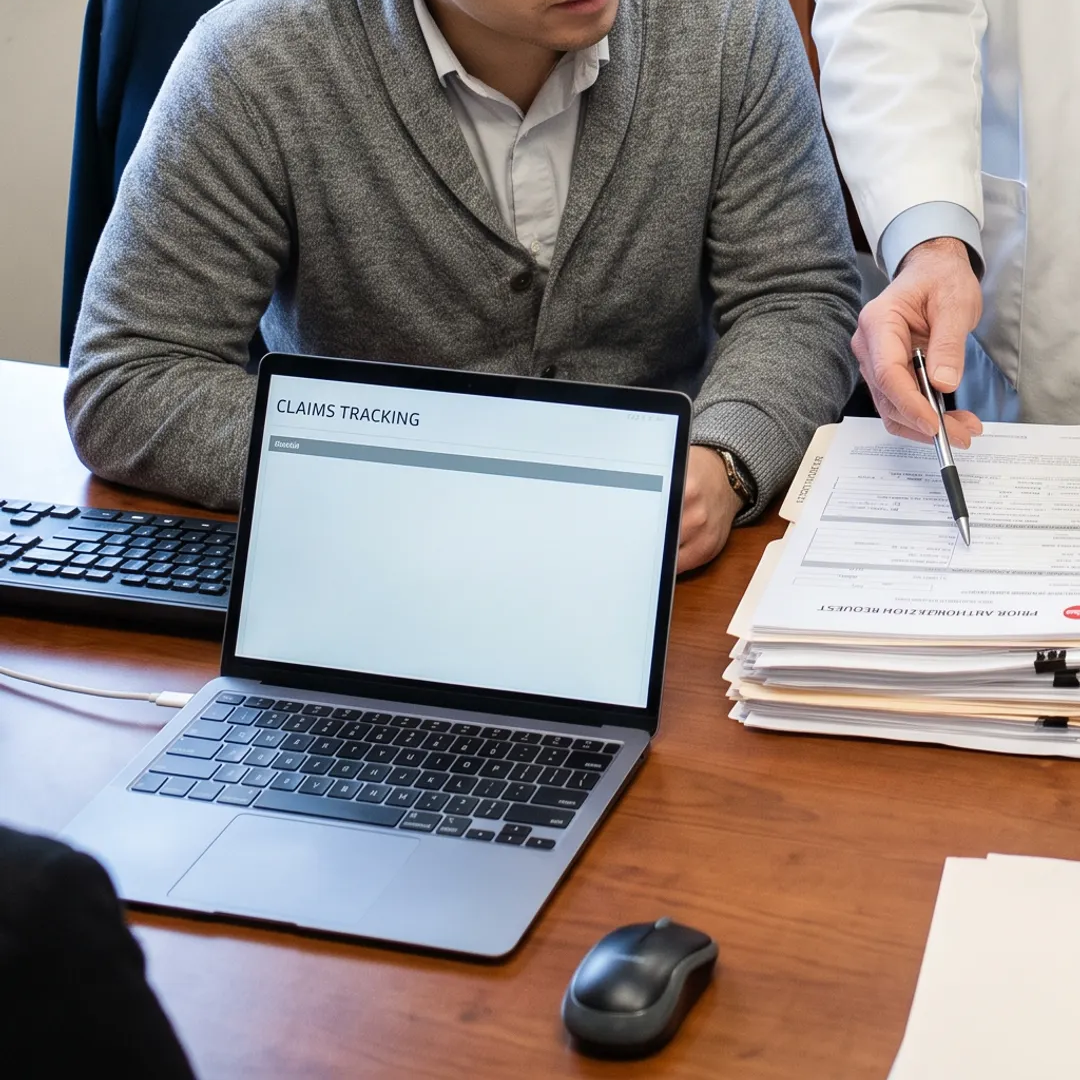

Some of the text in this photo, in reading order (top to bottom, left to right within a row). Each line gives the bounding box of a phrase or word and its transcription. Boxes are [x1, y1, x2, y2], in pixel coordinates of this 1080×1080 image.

[277, 398, 420, 427] CLAIMS TRACKING
[997, 609, 1039, 617] PRIOR
